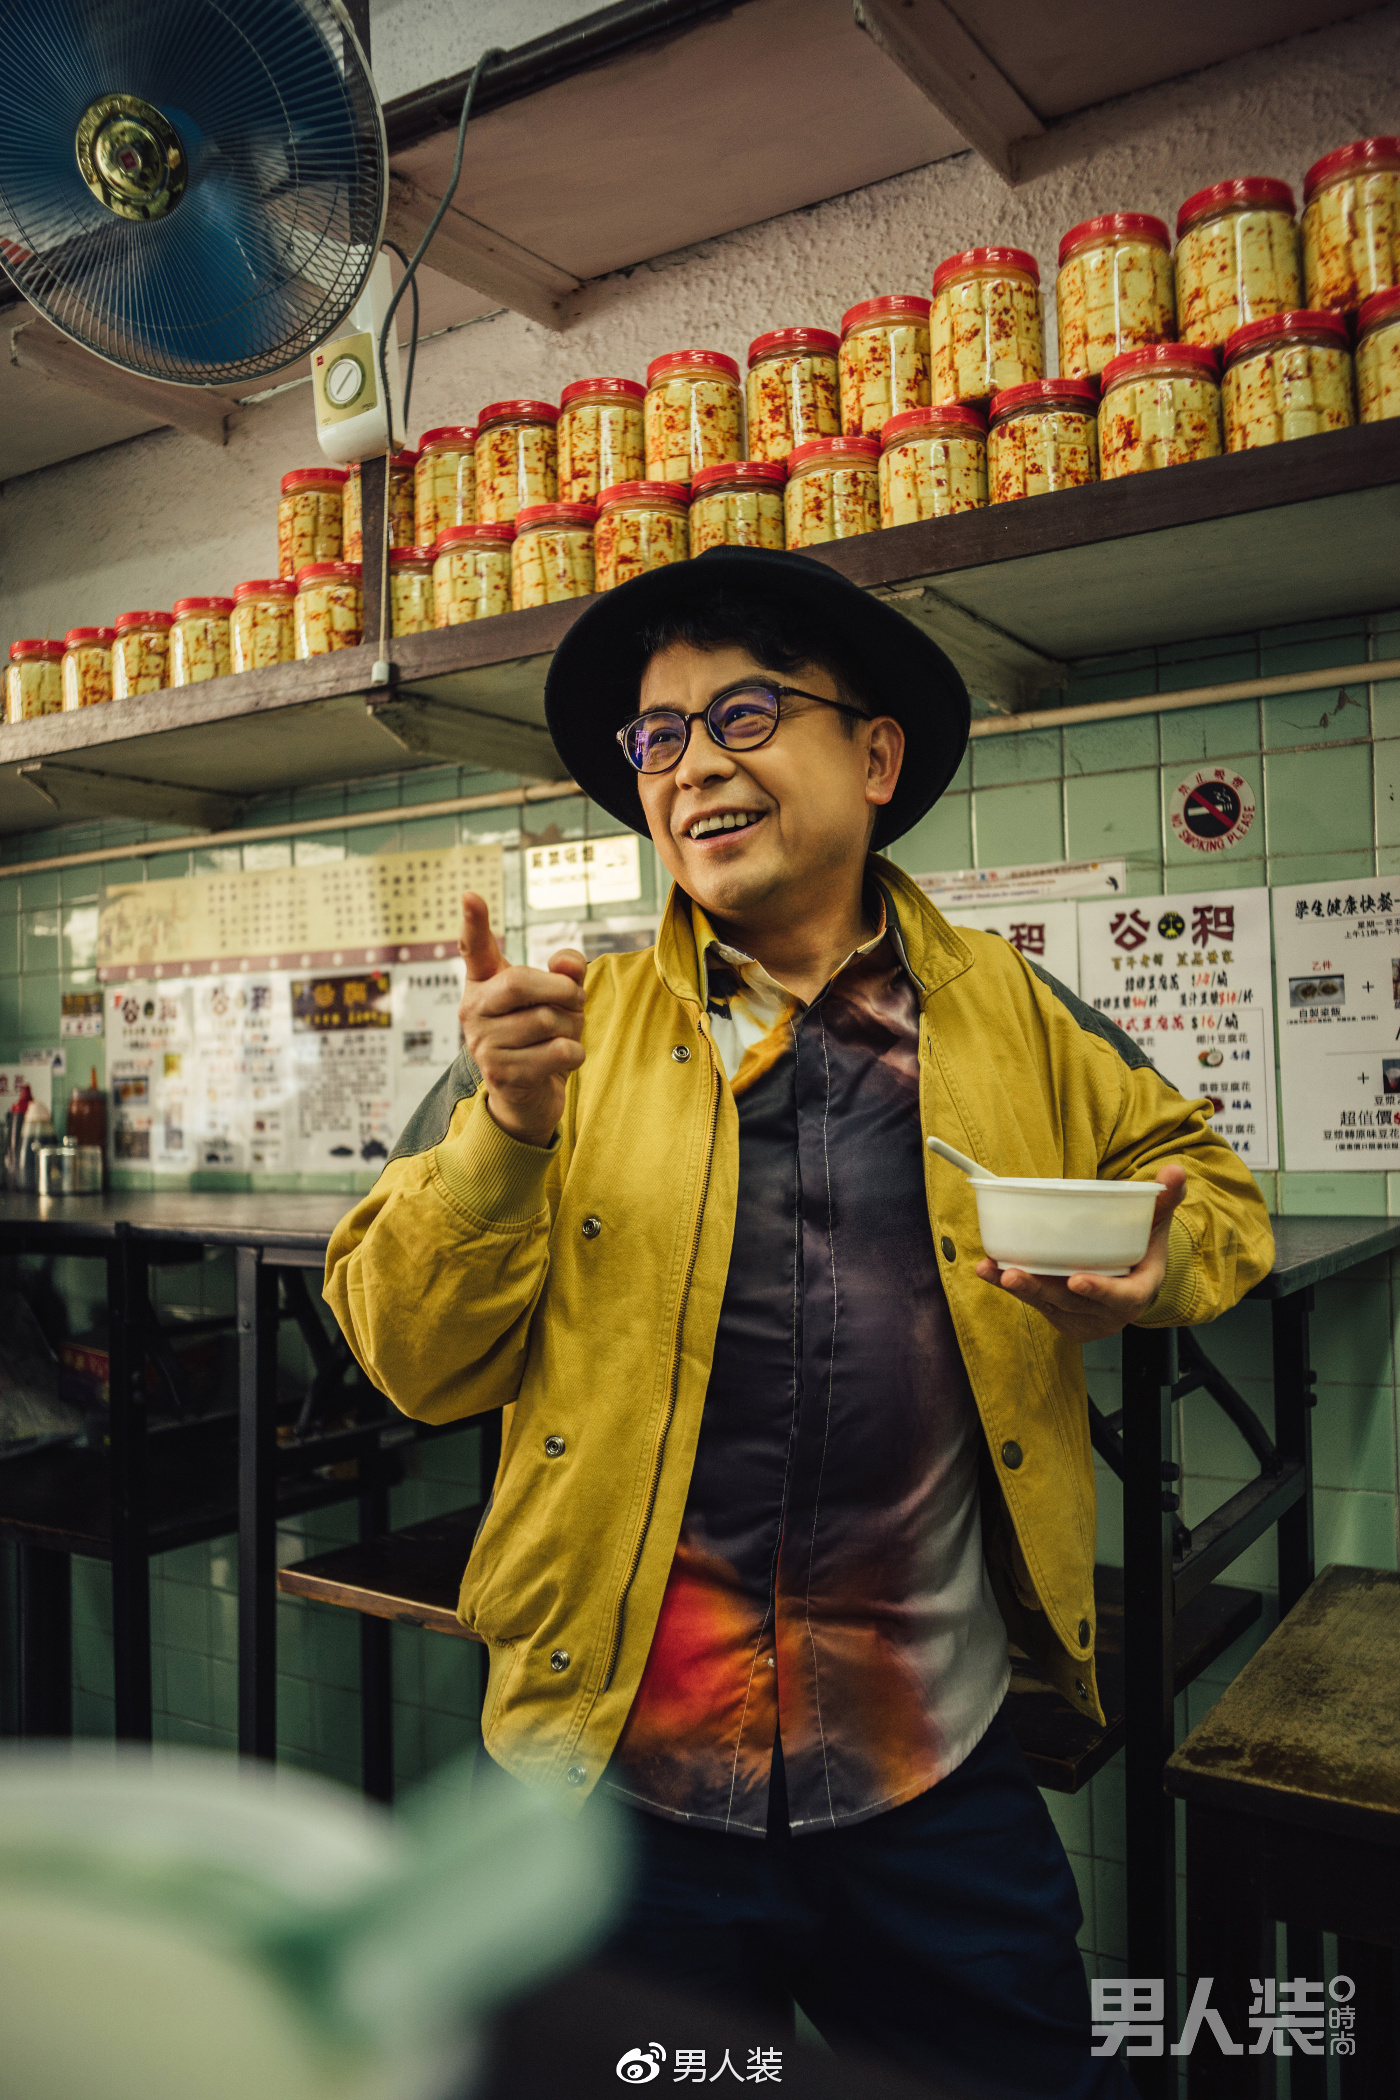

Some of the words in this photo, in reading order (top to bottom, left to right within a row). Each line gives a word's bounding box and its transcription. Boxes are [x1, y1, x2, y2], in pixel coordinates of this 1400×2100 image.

[1179, 829, 1225, 852] SMOKING
[1226, 805, 1256, 846] PLEASE
[1191, 905, 1235, 948] 和
[1210, 1123, 1256, 1135] 拼豆腐花
